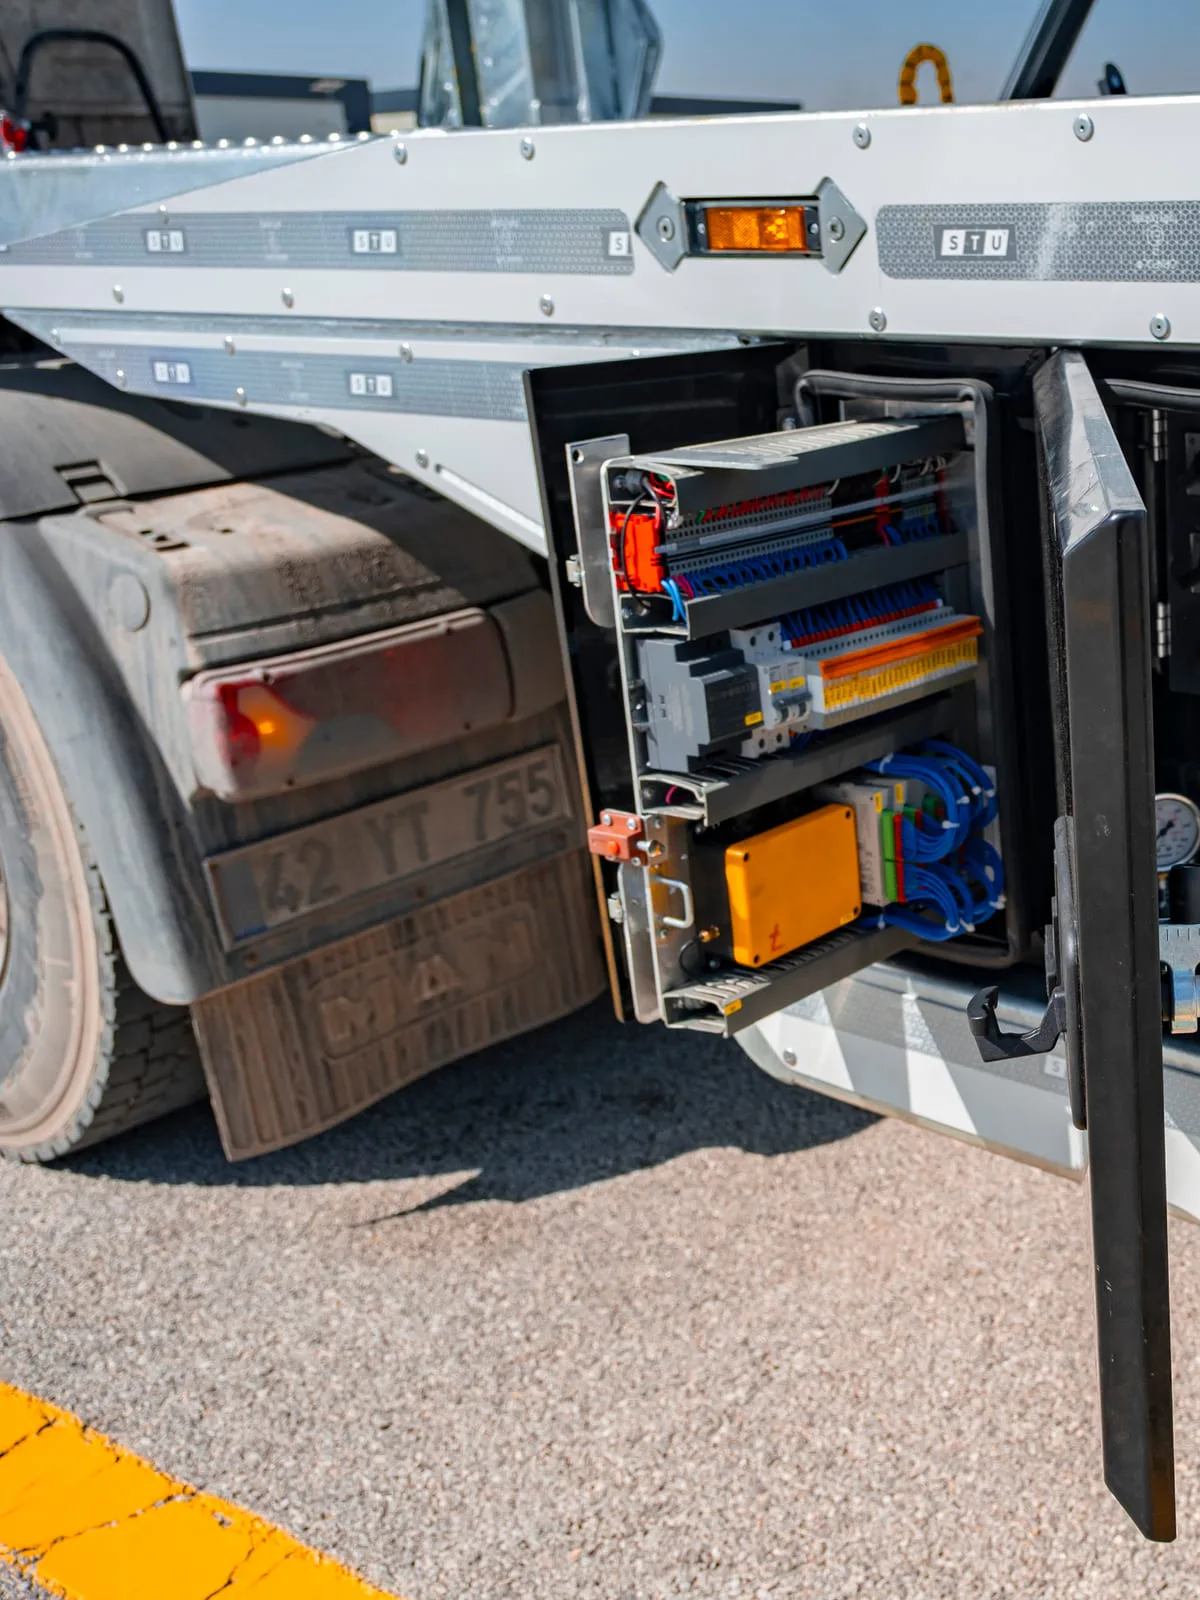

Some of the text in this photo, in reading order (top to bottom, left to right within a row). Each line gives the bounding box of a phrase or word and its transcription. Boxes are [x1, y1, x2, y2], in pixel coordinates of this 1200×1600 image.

[947, 233, 1003, 252] STU
[262, 760, 556, 913] 42 YT 755
